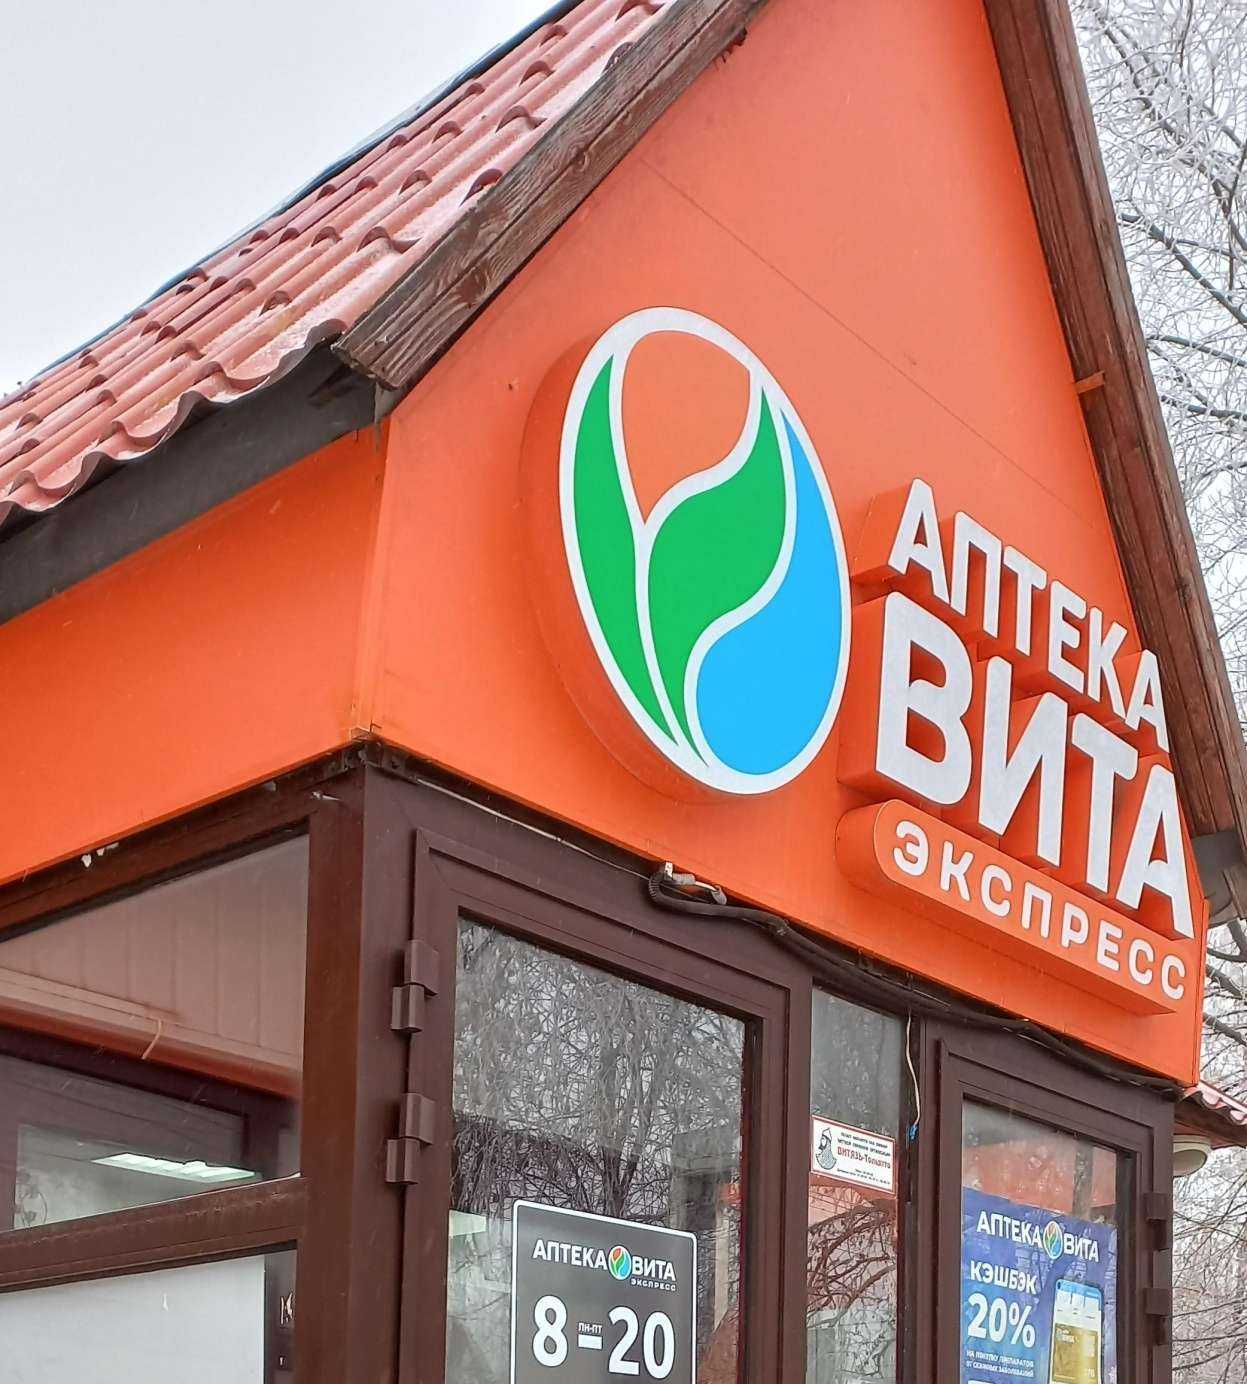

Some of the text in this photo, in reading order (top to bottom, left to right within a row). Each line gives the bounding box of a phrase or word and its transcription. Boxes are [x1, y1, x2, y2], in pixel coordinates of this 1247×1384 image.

[887, 477, 1169, 754] АПТЕКА
[876, 591, 1195, 940] ВИТА
[893, 819, 1186, 1000] ЭКСПРЕСС
[532, 1239, 677, 1282] АПТЕКА ВИТА
[976, 1210, 1100, 1263] АПТЕКА ВИТА
[631, 1278, 677, 1292] ЭКСПРЕСС
[970, 1260, 1038, 1295] КЭШБЭК
[578, 1322, 603, 1334] ПН-ПТ
[967, 1292, 1036, 1349] 20%
